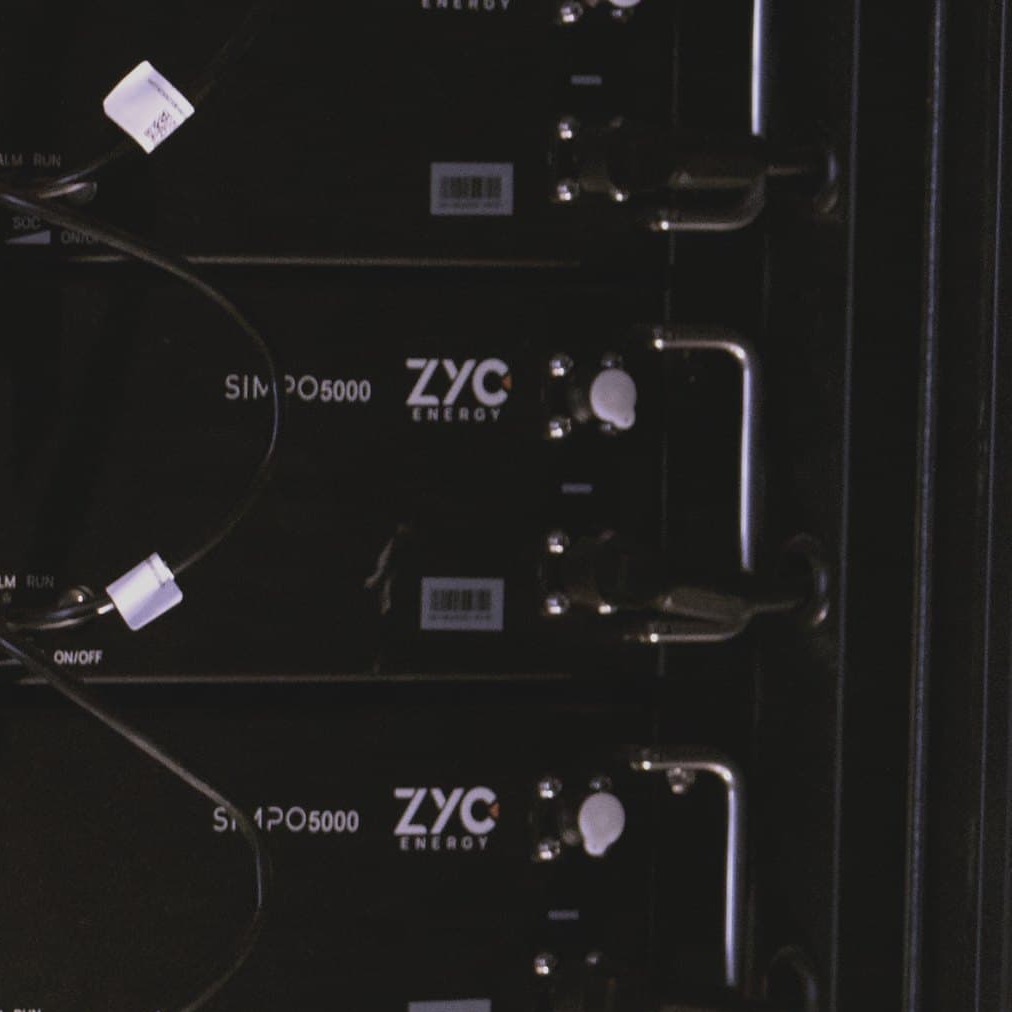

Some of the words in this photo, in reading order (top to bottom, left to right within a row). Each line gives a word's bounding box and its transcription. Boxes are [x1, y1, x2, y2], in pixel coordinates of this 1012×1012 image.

[33, 152, 61, 166] RUN
[405, 357, 512, 407] ZYC
[411, 406, 501, 422] ENERGY
[26, 574, 54, 589] RUN
[53, 649, 103, 665] ON/OFF
[393, 786, 501, 836] ZYC
[399, 834, 489, 851] ENERGY
